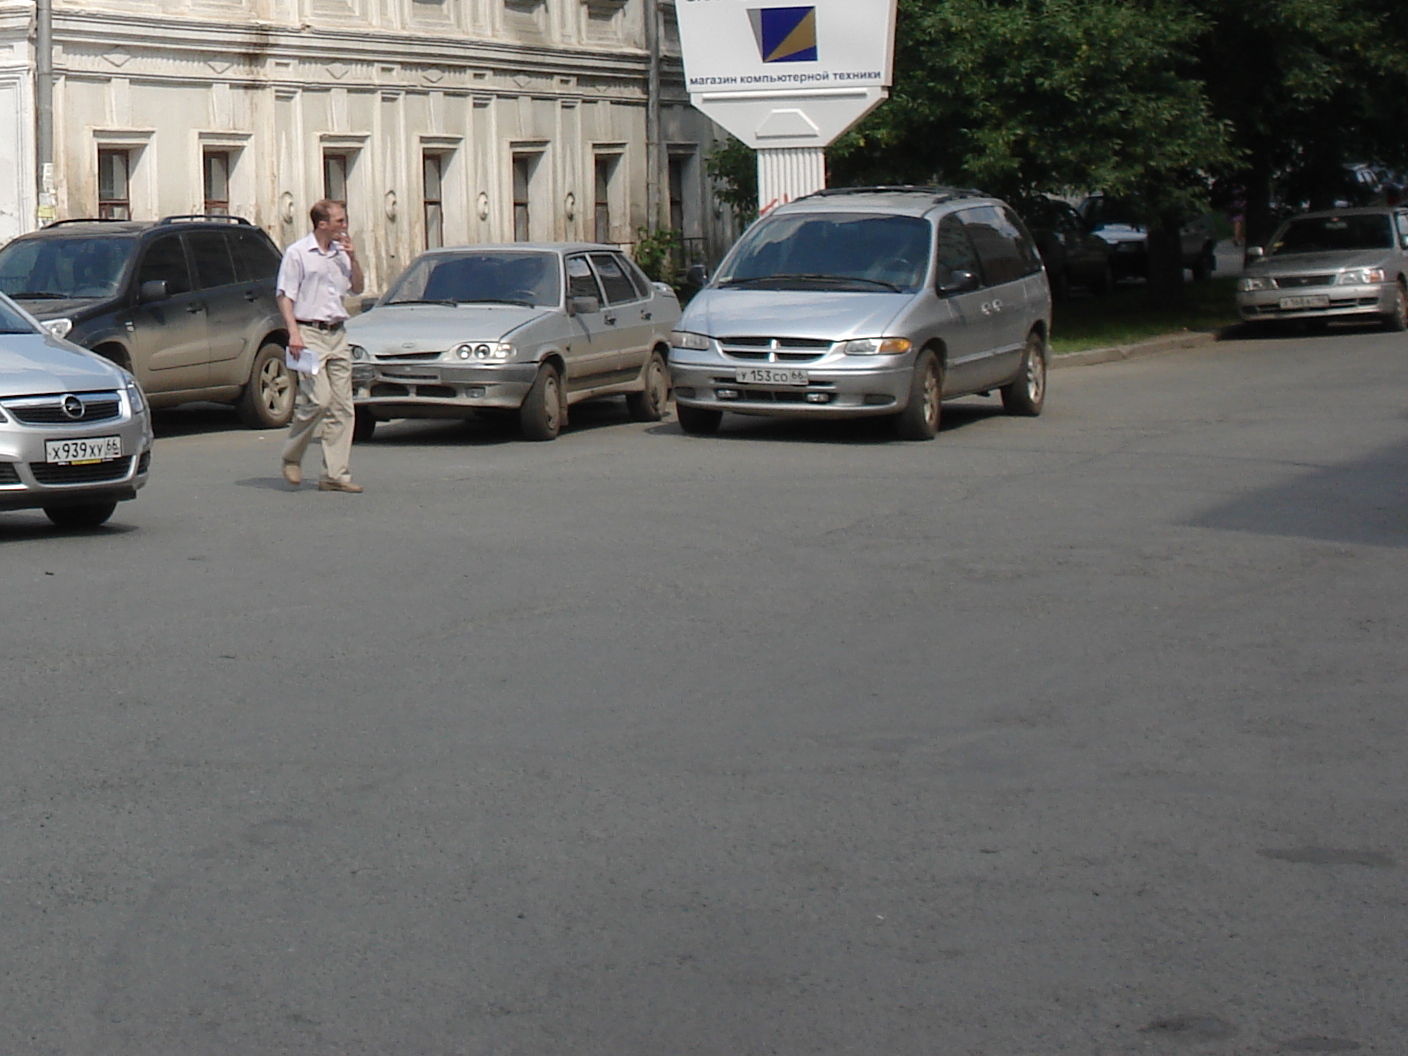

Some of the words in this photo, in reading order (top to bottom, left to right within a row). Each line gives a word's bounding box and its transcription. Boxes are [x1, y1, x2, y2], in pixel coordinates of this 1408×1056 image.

[689, 75, 737, 86] магазин
[740, 71, 829, 85] компьютерной
[832, 70, 881, 81] техники
